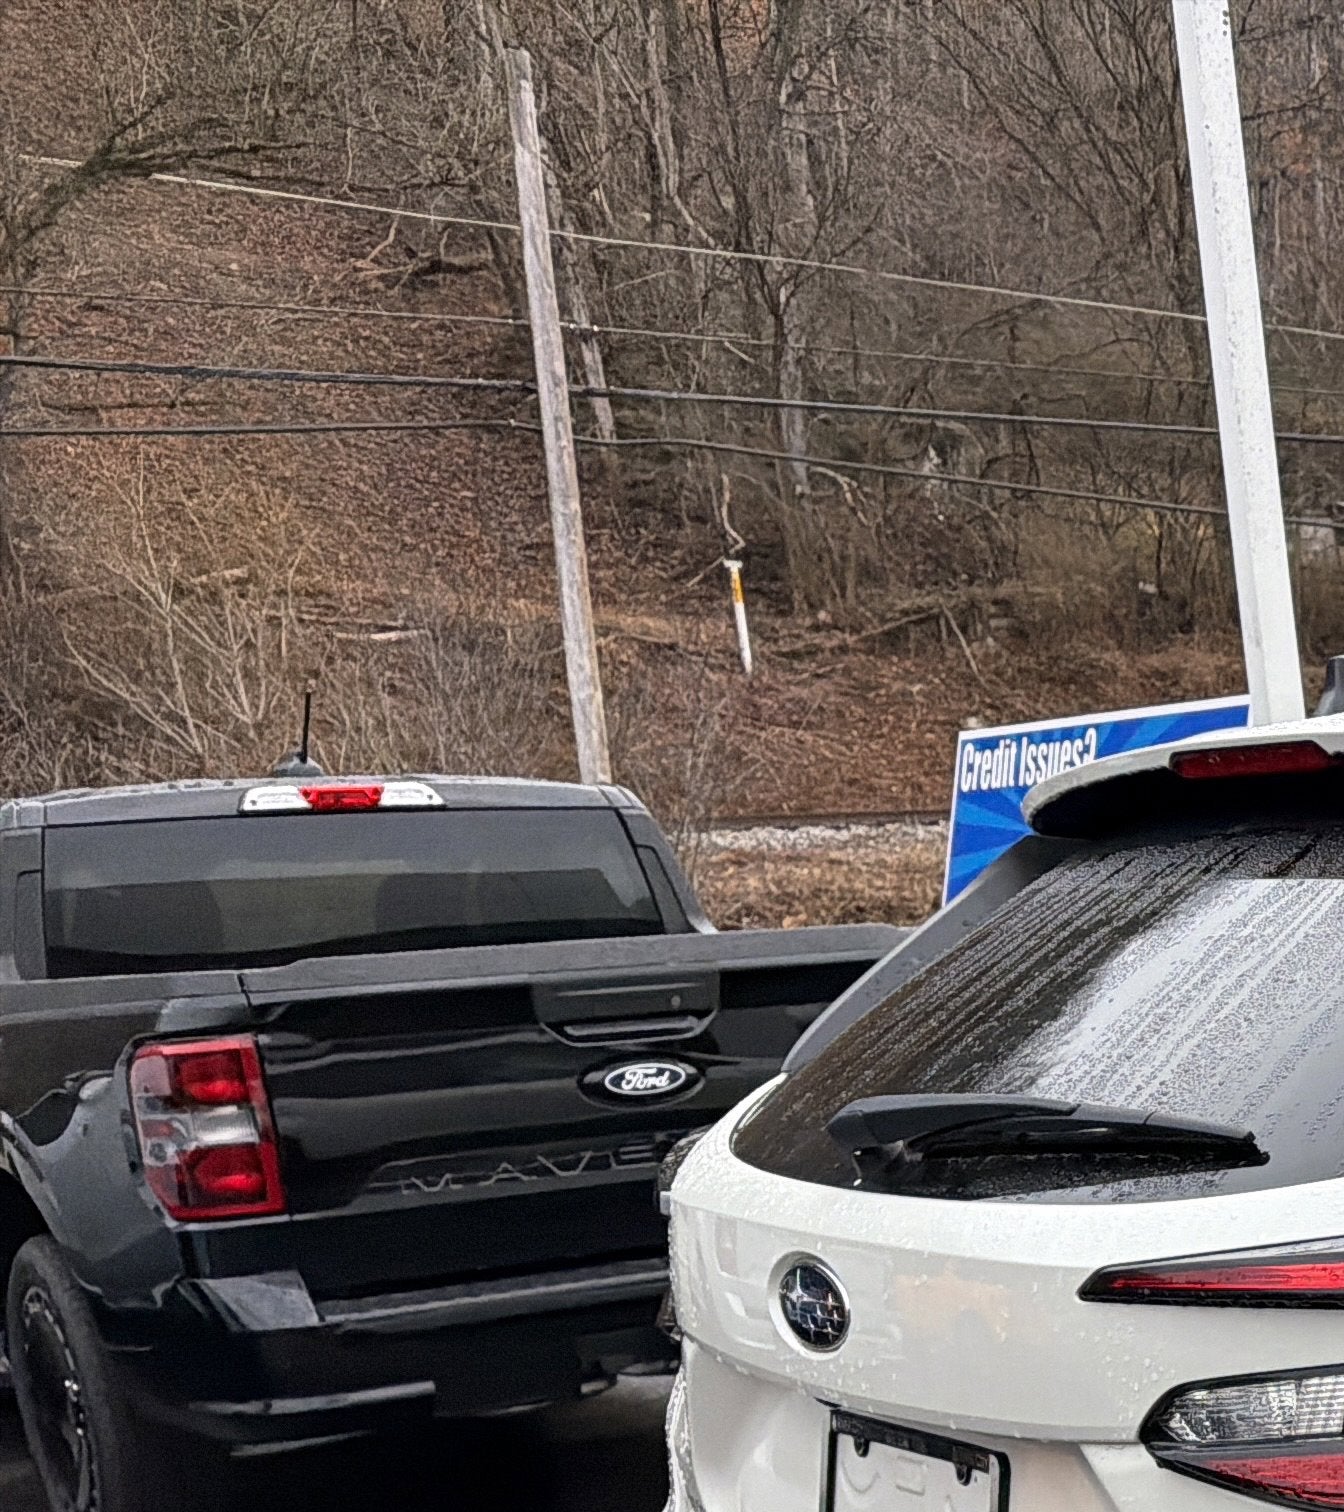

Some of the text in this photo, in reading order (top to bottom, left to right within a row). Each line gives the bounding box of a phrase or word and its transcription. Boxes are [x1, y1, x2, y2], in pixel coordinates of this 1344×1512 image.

[960, 727, 1097, 793] Credit Issues?
[621, 1067, 671, 1091] Ford
[401, 1139, 659, 1195] MAVE
